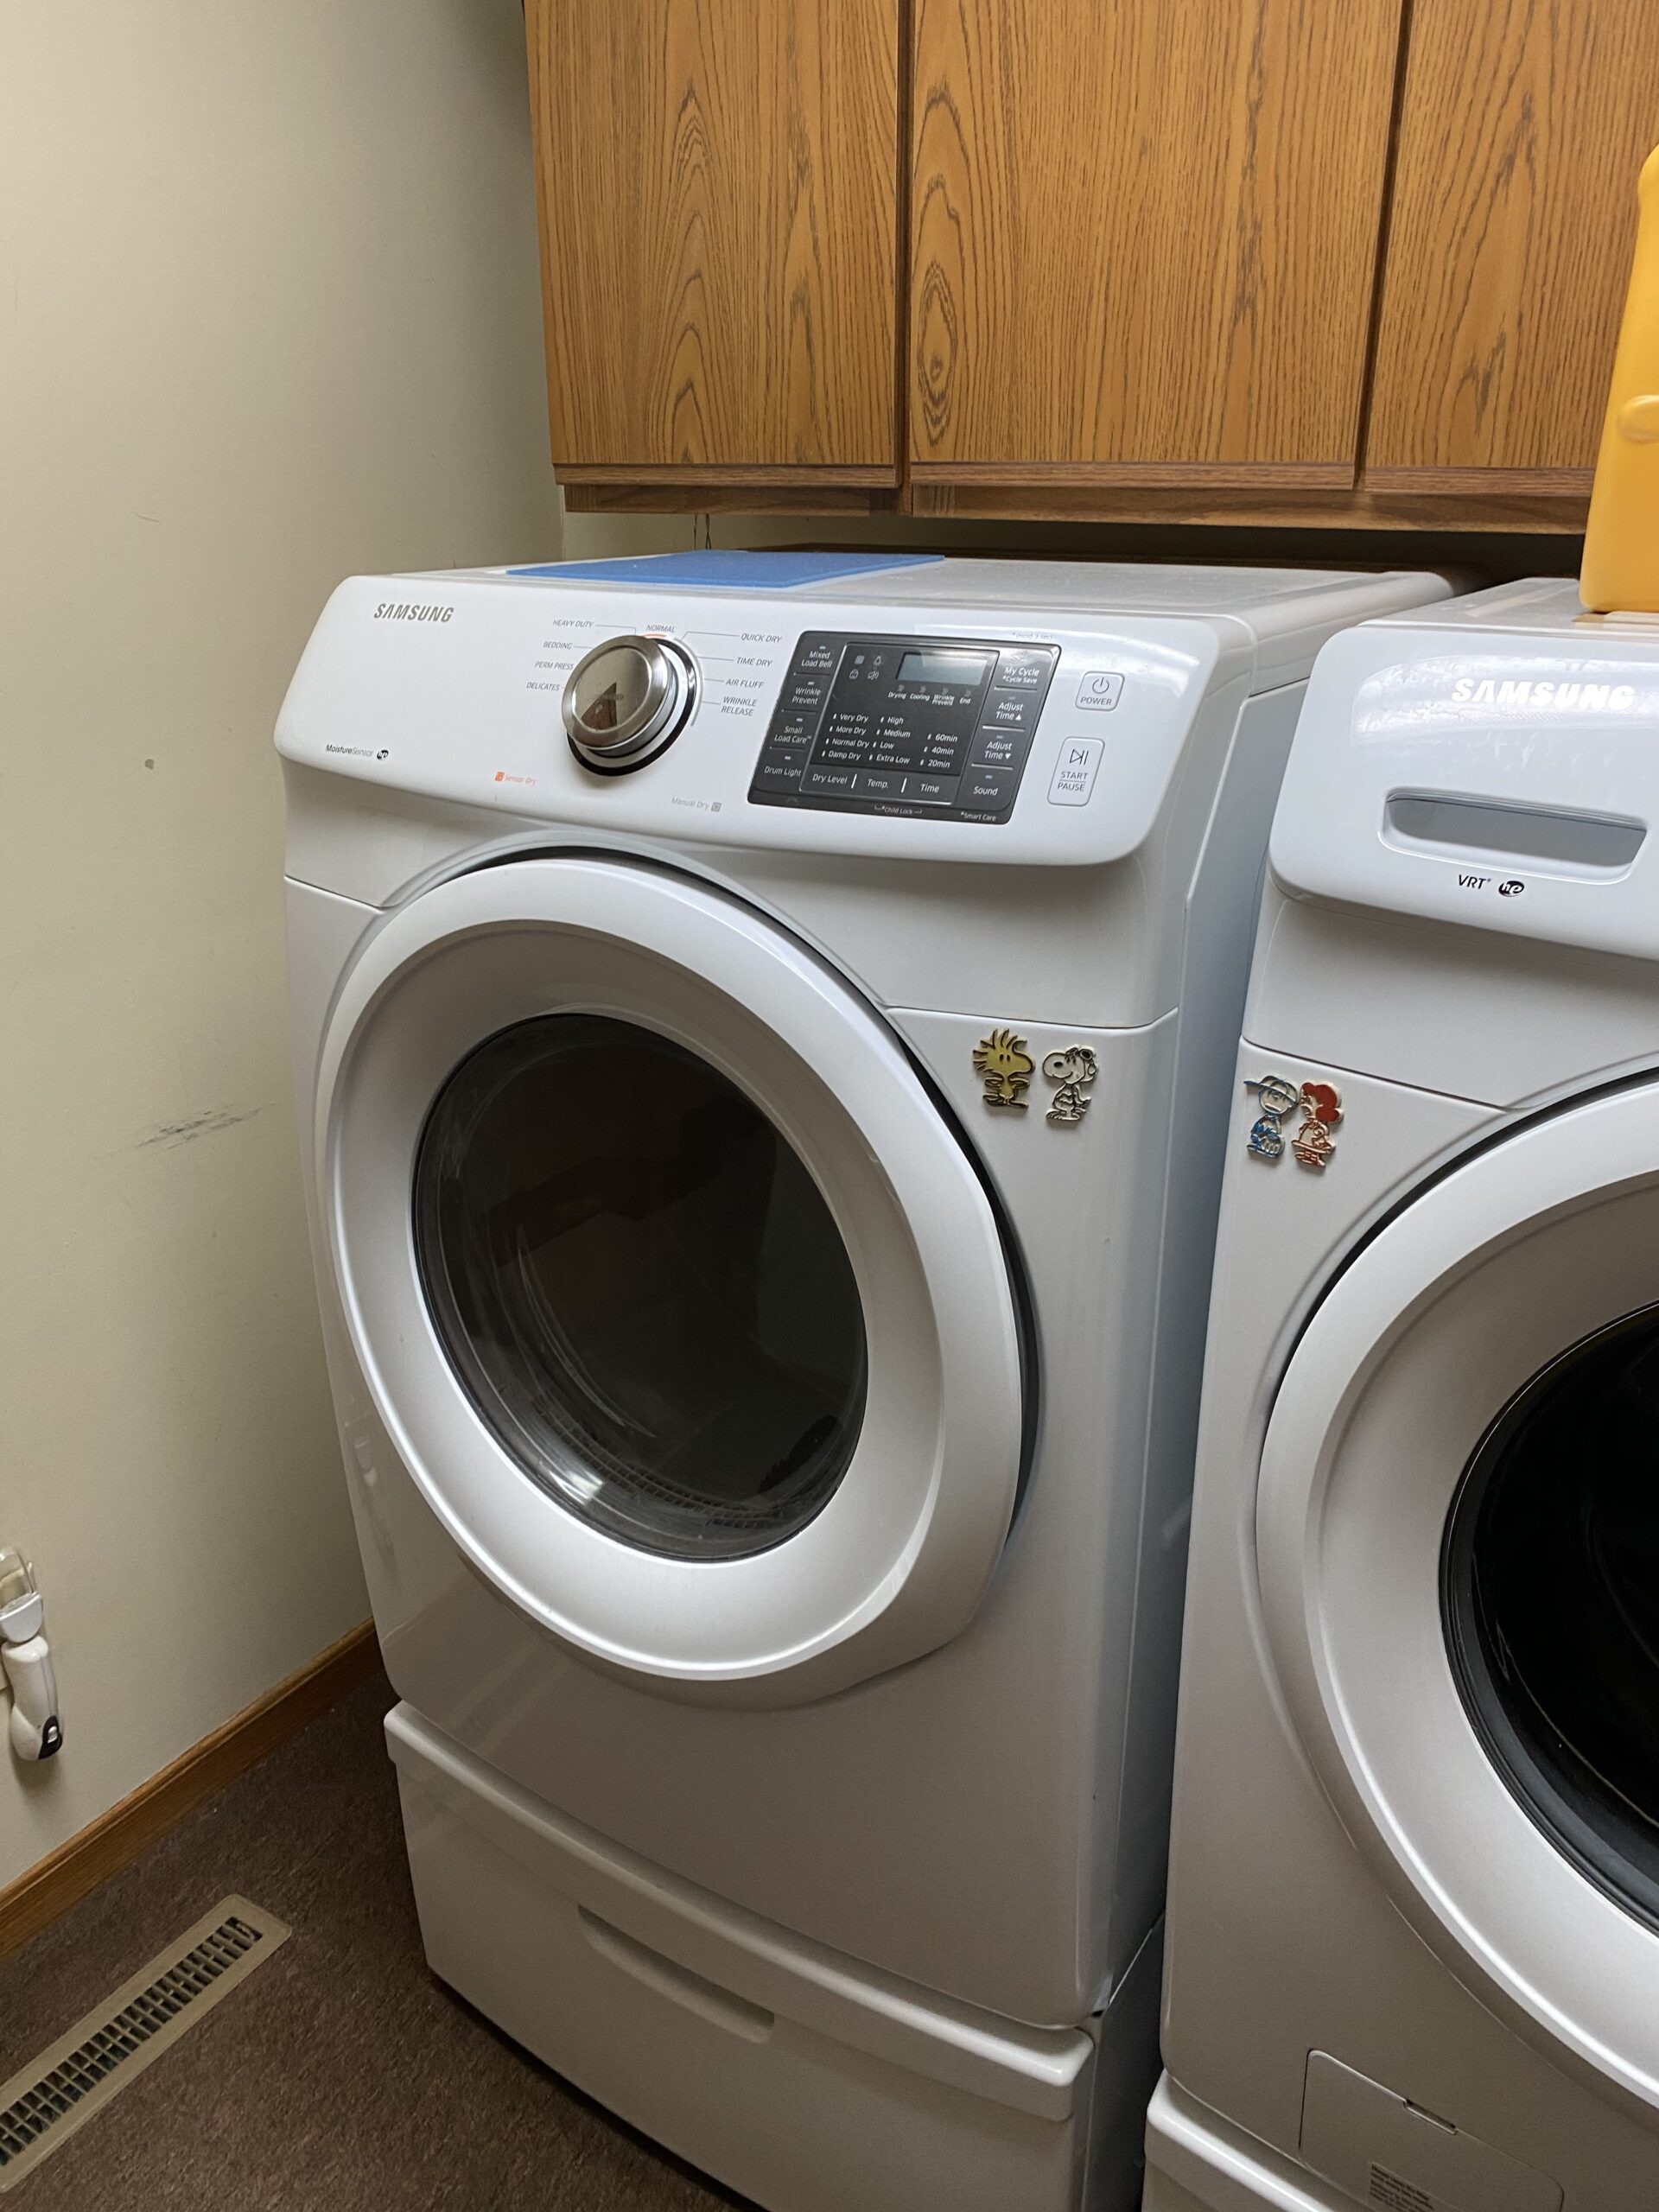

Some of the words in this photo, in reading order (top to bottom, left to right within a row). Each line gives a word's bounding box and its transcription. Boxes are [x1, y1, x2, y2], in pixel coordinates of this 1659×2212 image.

[373, 603, 454, 623] SAMSUNG
[646, 625, 675, 633] NORMAL
[741, 632, 765, 642] QUICK
[543, 641, 573, 650] BEDDING
[736, 657, 755, 665] TIME
[756, 658, 772, 667] DRY
[801, 659, 818, 668] Load
[819, 660, 832, 669] Bell
[1004, 667, 1017, 677] My
[1018, 668, 1039, 677] Cycle
[526, 682, 560, 691] DELICATES
[741, 680, 764, 689] FLUFF
[796, 687, 821, 696] Wrinkle
[888, 691, 906, 700] Drying
[1451, 677, 1637, 711] SAMSUNG
[723, 696, 758, 707] WRINKLE
[791, 696, 818, 705] Prevent
[910, 693, 930, 702] Cooling
[1080, 696, 1113, 706] POWER
[721, 705, 754, 716] RELEASE
[998, 701, 1024, 712] Adjust
[839, 713, 855, 722] Very
[855, 714, 869, 723] Dry
[887, 716, 904, 725] High
[995, 711, 1014, 721] Time
[784, 726, 803, 734] Small
[836, 725, 853, 734] More
[854, 727, 867, 735] Dry
[883, 728, 911, 738] Medium
[774, 734, 791, 743] Load
[832, 738, 856, 747] Normal
[856, 740, 869, 749] Dry
[935, 734, 958, 743] 60min
[880, 741, 894, 750] Low
[931, 746, 954, 755] 40min
[986, 741, 1013, 752] Adjust
[828, 750, 848, 760] Damp
[848, 752, 861, 760] Dry
[876, 753, 894, 763] Extra
[895, 755, 911, 765] Low
[984, 750, 1003, 760] Time
[927, 759, 950, 768] 20min
[764, 766, 783, 774] Drum
[784, 767, 801, 778] Light
[1059, 770, 1089, 780] START
[505, 774, 524, 783] Sensor
[525, 777, 537, 786] Dry
[812, 772, 827, 783] Dry
[828, 774, 848, 785] Level
[868, 779, 889, 789] Temp.
[920, 784, 940, 793] Time
[1057, 781, 1085, 792] PAUSE
[973, 785, 999, 797] Sound
[671, 797, 696, 807] Manual
[696, 801, 709, 810] Dry
[982, 813, 996, 822] Care
